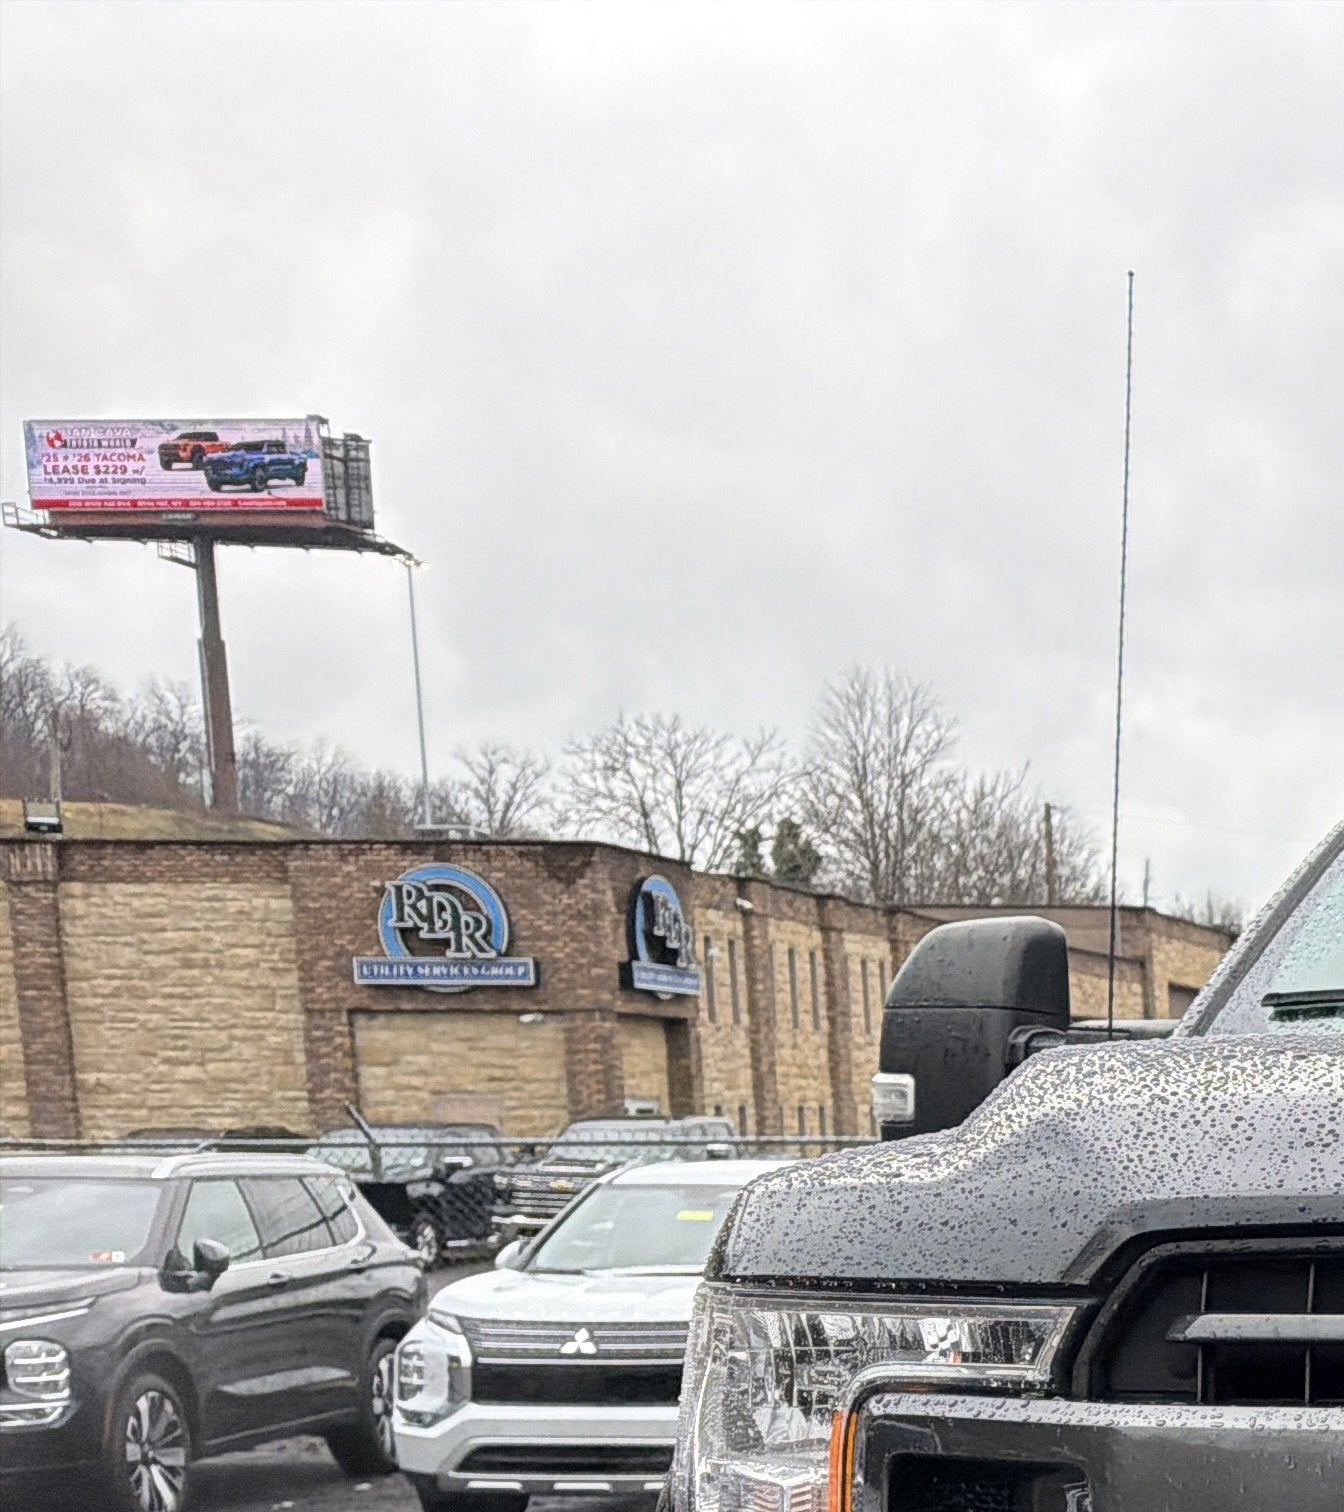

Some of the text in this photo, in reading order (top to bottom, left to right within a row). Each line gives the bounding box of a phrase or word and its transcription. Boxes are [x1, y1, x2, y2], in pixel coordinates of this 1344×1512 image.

[73, 453, 91, 463] '26
[95, 453, 146, 463] TACOMA
[43, 464, 90, 476] LEASE
[93, 464, 128, 476] $229
[77, 477, 96, 485] Due
[99, 477, 109, 485] at
[111, 477, 147, 486] Signing
[385, 881, 497, 958] RDR
